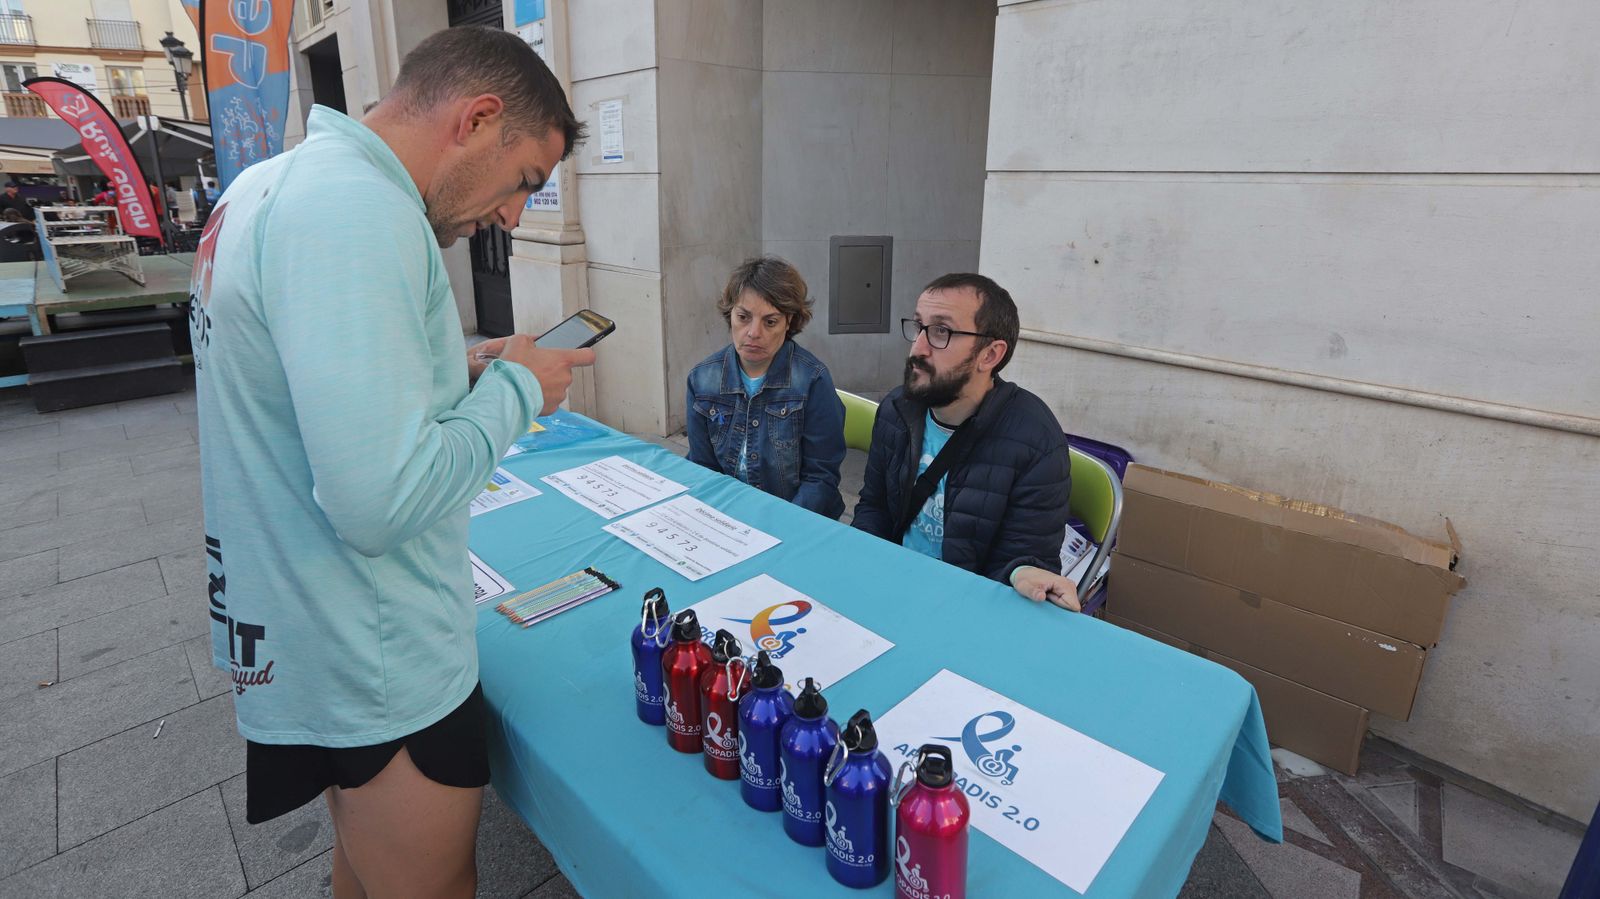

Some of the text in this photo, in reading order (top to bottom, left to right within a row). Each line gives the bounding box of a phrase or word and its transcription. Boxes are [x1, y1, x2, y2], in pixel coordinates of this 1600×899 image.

[688, 724, 702, 733] 2.0
[766, 777, 781, 786] 2.0
[806, 811, 822, 819] 2.0
[1002, 805, 1040, 831] 2.0
[858, 854, 875, 864] 2.0
